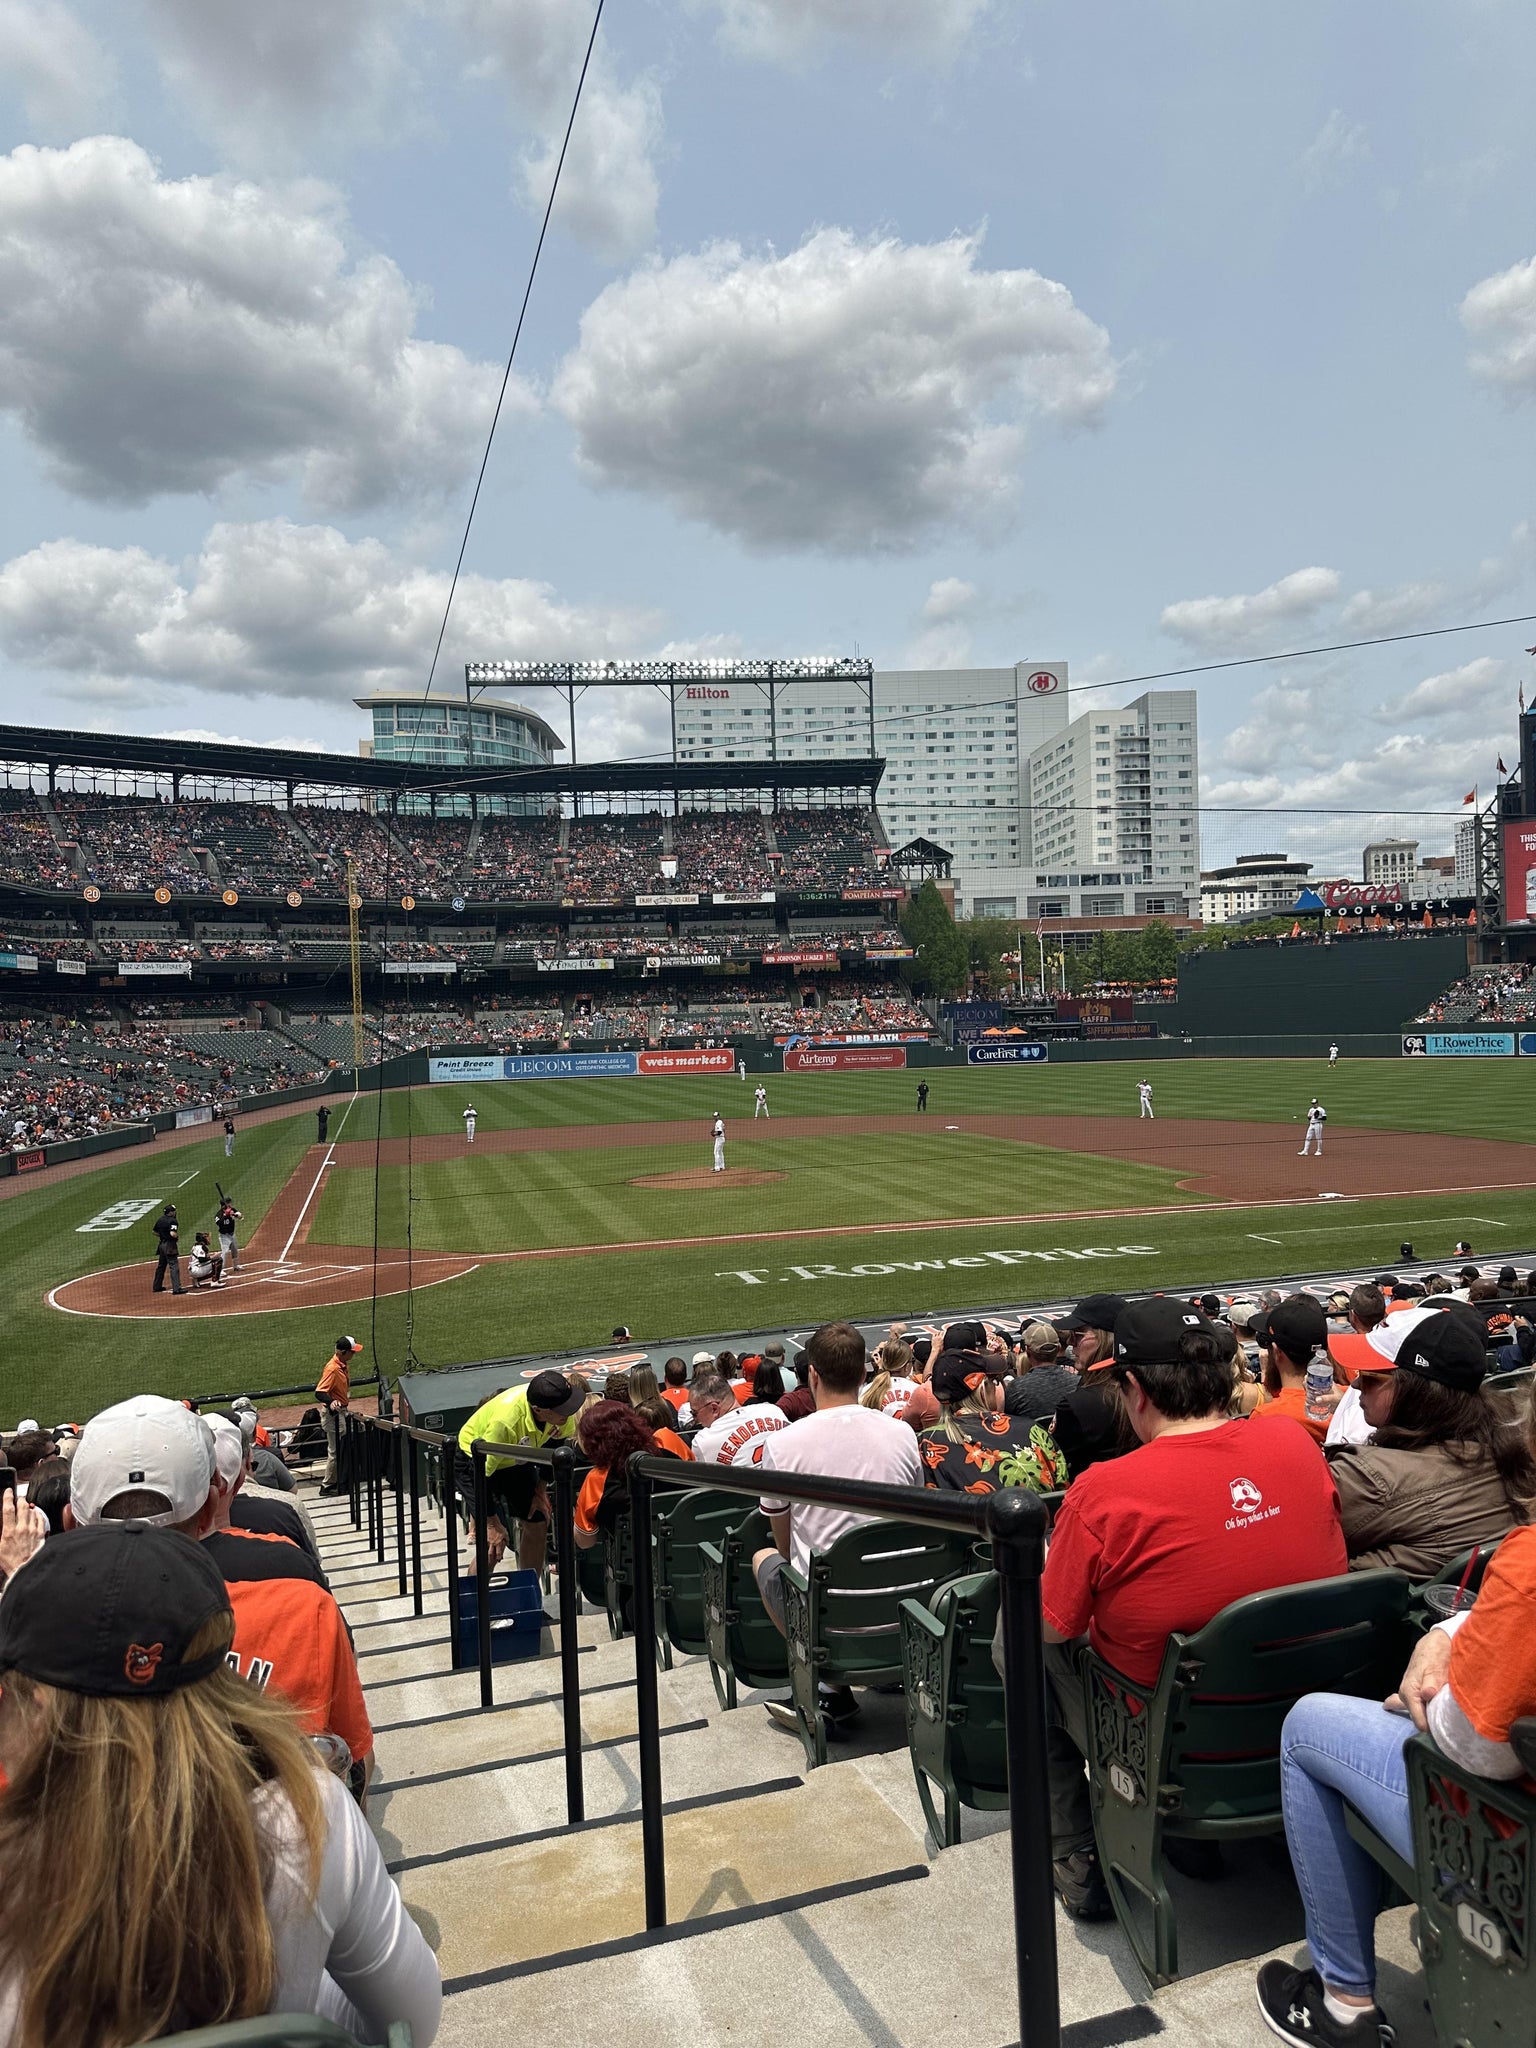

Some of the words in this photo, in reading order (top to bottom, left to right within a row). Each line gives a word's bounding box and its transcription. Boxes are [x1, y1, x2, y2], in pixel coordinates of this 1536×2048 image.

[687, 687, 729, 698] Hilton
[86, 889, 98, 899] 20
[160, 891, 166, 900] 5
[227, 893, 233, 902] 4
[844, 892, 880, 900] POMPEIAN
[1325, 879, 1403, 907] Coors
[289, 895, 300, 904] 22
[350, 897, 361, 905] 33
[454, 901, 463, 909] 42
[1325, 905, 1377, 917] ROOF
[1395, 899, 1450, 912] DECK
[691, 955, 720, 965] UNION
[846, 1034, 870, 1043] BIRD
[873, 1033, 899, 1042] BATH
[958, 1030, 977, 1038] WE
[976, 1047, 1019, 1060] CareFirst
[645, 1056, 674, 1067] weis
[676, 1054, 728, 1065] markets
[799, 1053, 837, 1066] Airtemp
[18, 1154, 41, 1168] SEATGEEK
[1225, 1518, 1236, 1530] Oh
[1236, 1516, 1248, 1528] boy
[1247, 1511, 1264, 1524] what
[1264, 1510, 1269, 1518] a
[1268, 1505, 1280, 1516] beer
[922, 1695, 932, 1714] 14
[1117, 1771, 1130, 1795] 15
[1468, 1911, 1493, 1949] 16
